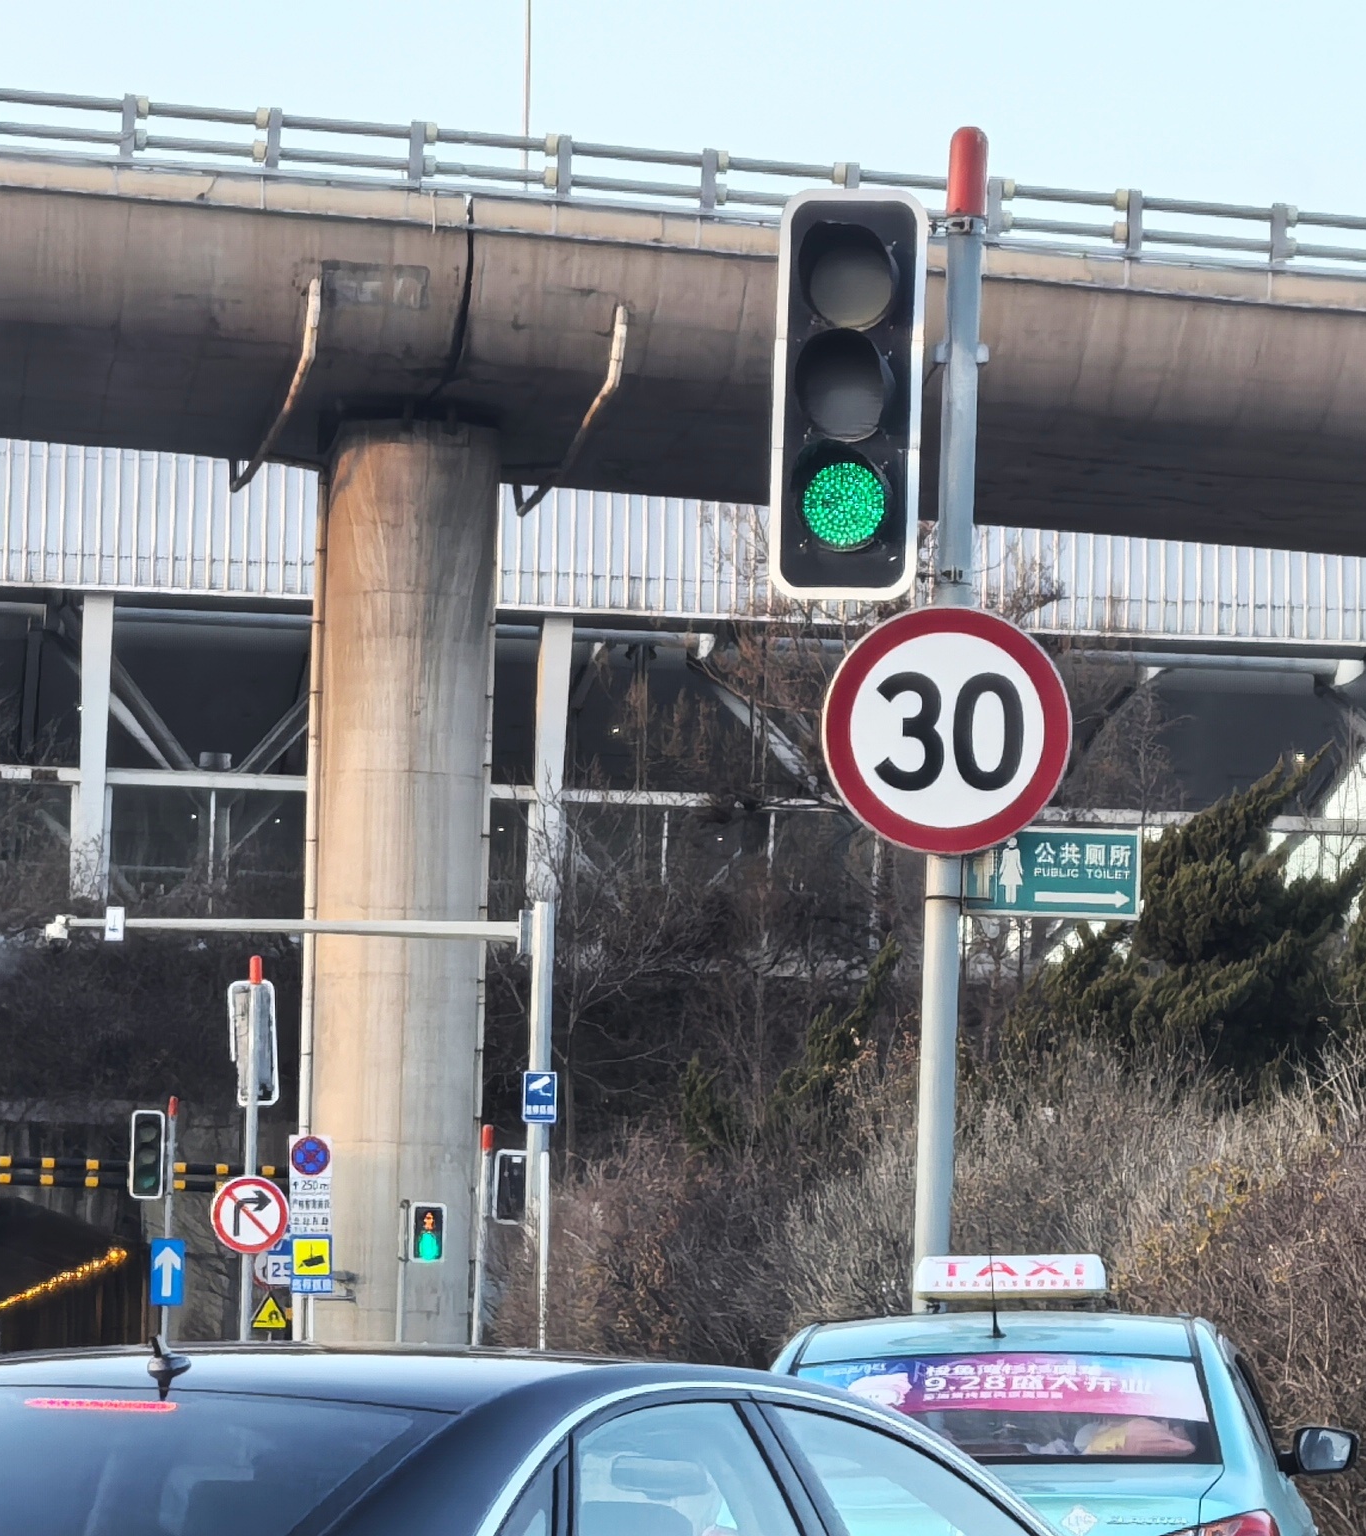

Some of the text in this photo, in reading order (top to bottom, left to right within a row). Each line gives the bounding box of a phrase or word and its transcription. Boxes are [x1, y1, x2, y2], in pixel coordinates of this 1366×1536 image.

[874, 671, 1024, 791] 30
[1034, 842, 1131, 867] 公共厕所
[1034, 867, 1131, 880] PUBLIC TOILET
